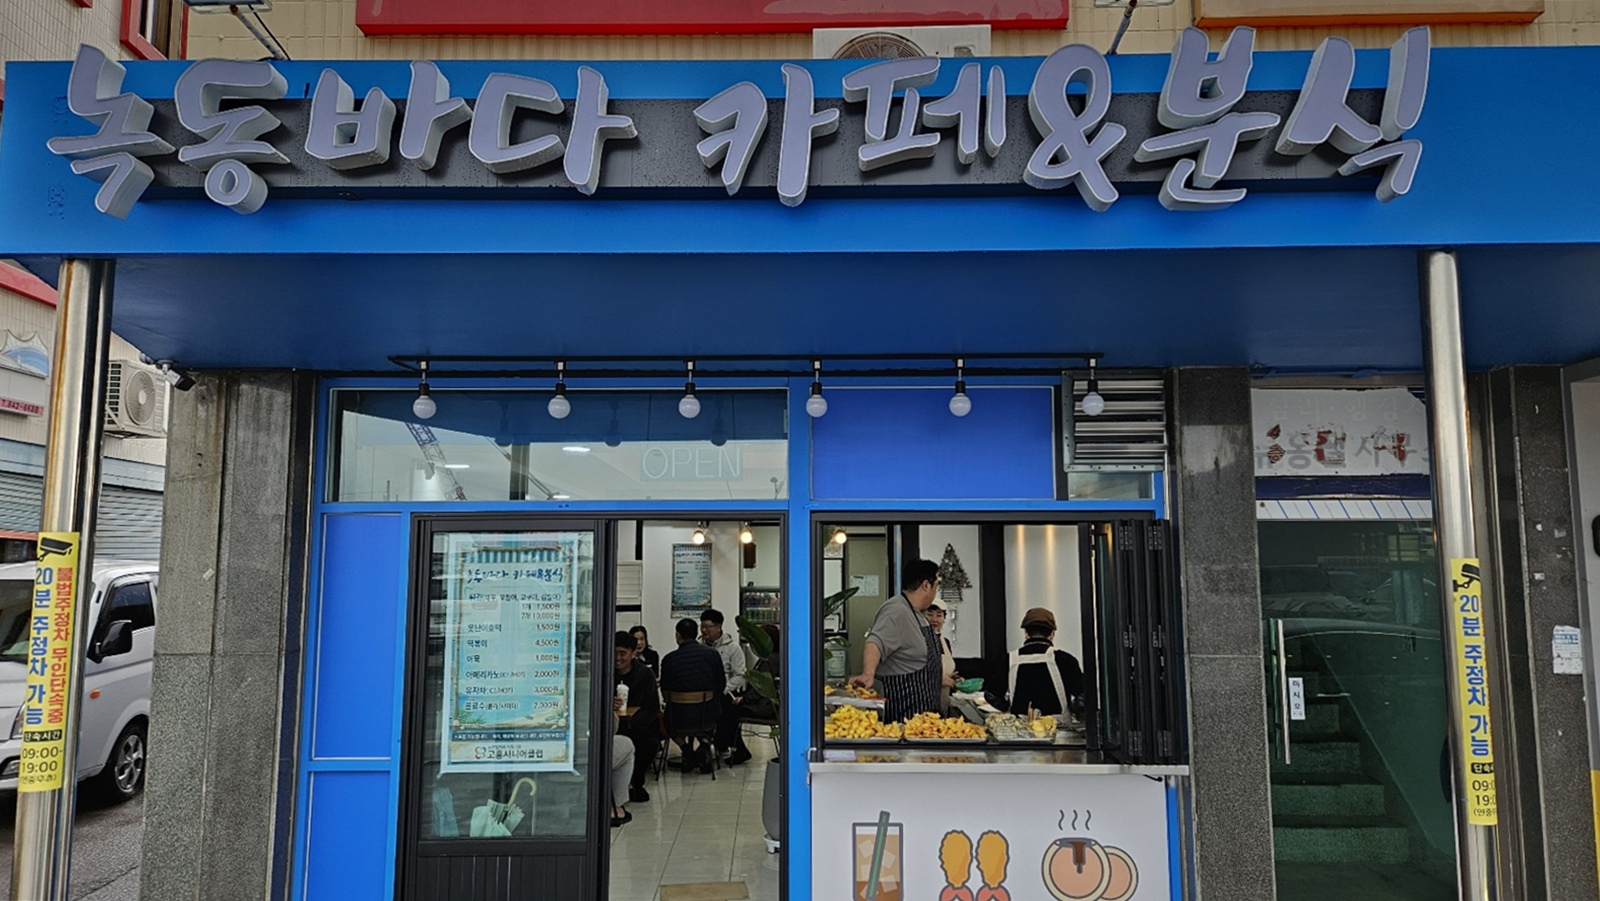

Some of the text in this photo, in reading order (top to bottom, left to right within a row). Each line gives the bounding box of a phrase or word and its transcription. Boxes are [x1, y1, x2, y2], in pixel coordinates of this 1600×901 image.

[47, 25, 1431, 218] 녹동바다 카페&분식
[642, 447, 740, 479] OPEN
[29, 616, 49, 676] 주정차
[48, 567, 73, 724] 불법주정차 무인단속중
[1464, 645, 1486, 706] 주정차
[26, 684, 46, 725] 가능
[24, 731, 61, 741] 단속시간
[487, 749, 543, 759] 고흥시니어클럽
[1469, 715, 1489, 756] 가능
[22, 760, 58, 774] 19:00
